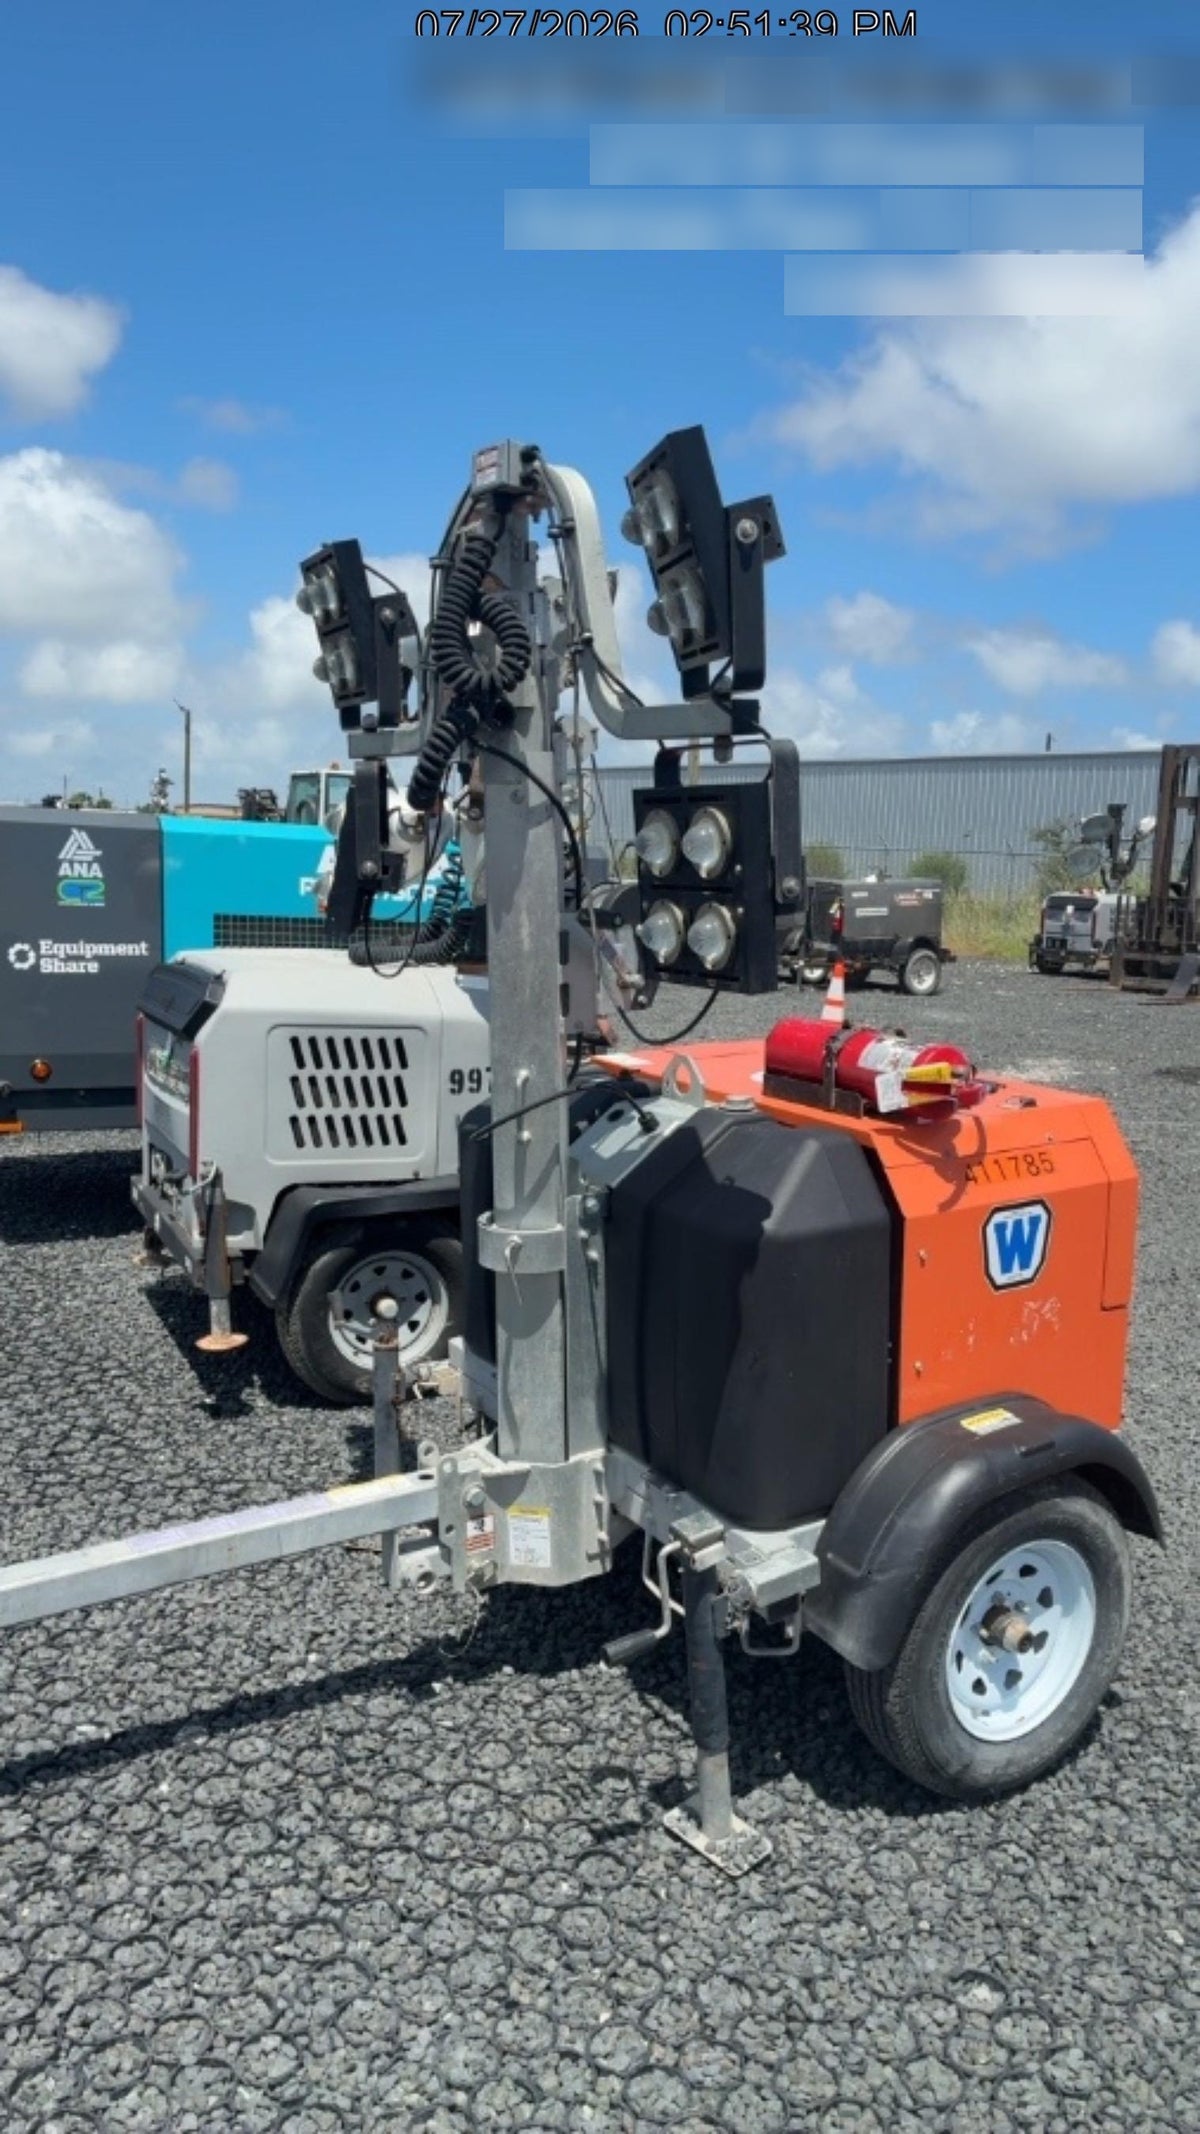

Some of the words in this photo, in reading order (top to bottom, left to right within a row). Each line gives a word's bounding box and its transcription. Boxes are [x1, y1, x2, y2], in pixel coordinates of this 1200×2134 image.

[58, 862, 103, 878] ANA
[39, 939, 149, 958] Equipment
[39, 957, 99, 973] Share
[965, 1152, 1055, 1184] 411785
[993, 1214, 1042, 1275] W
